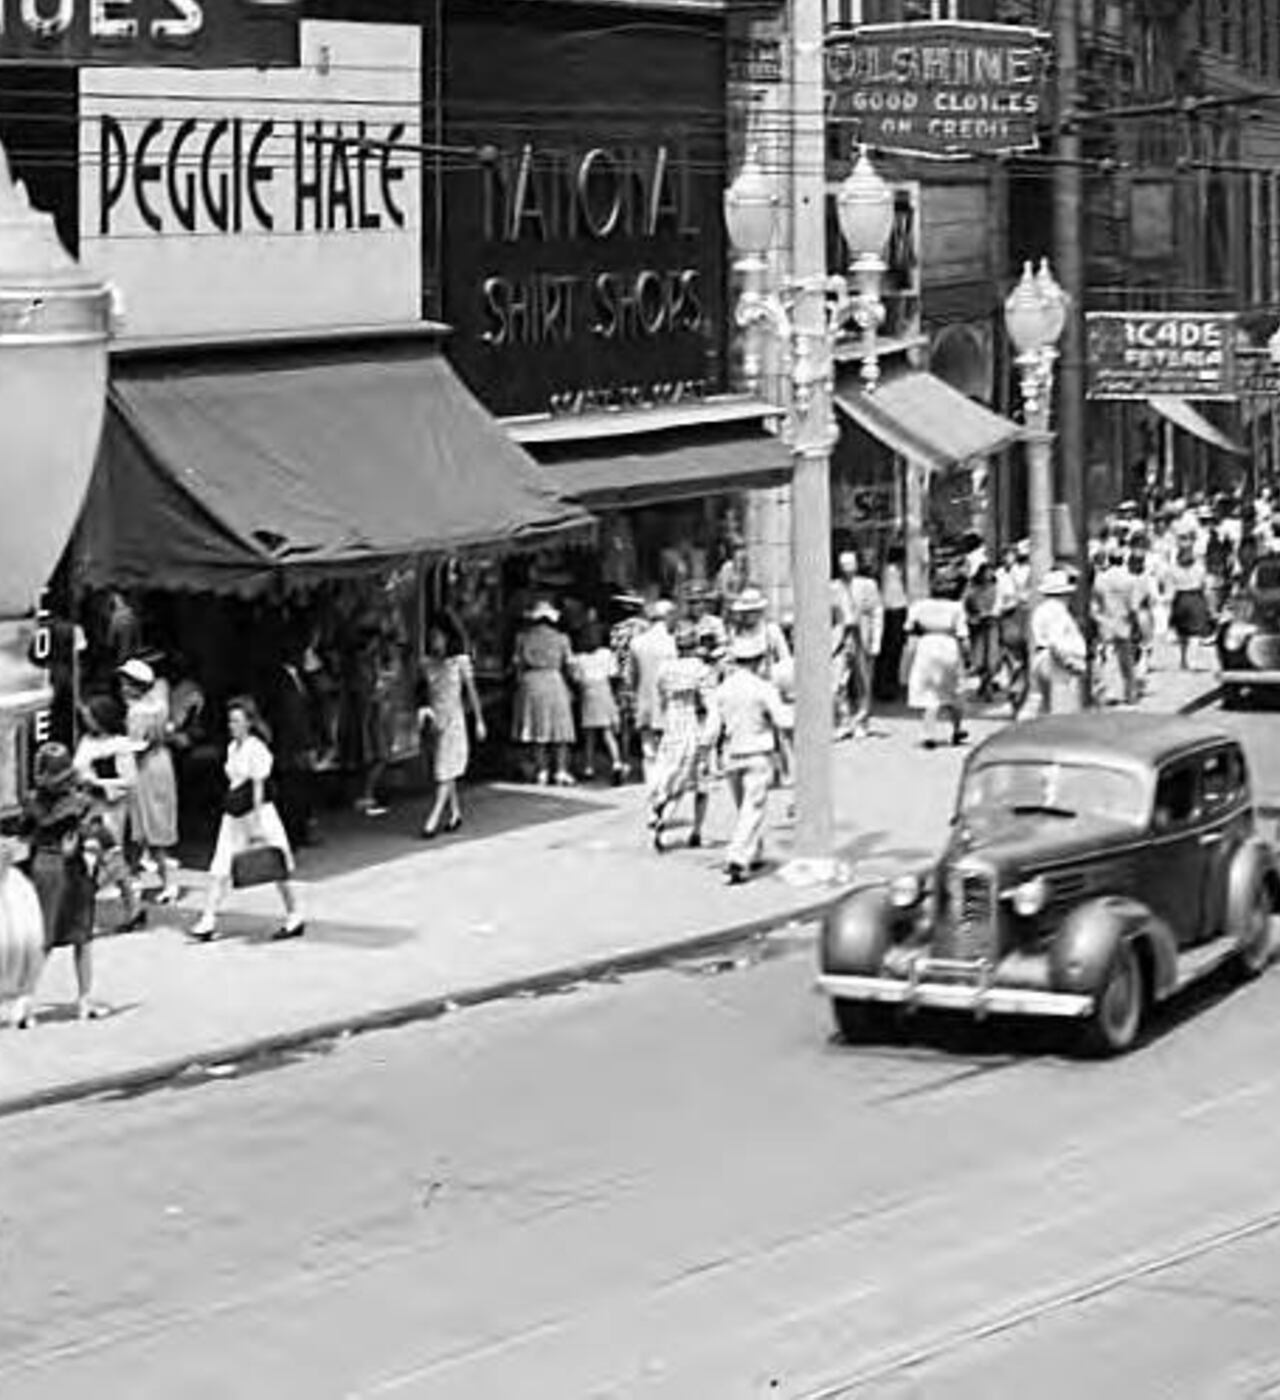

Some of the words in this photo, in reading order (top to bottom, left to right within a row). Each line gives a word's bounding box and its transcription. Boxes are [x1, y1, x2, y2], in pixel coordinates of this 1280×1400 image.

[852, 90, 919, 112] GOOD
[880, 117, 913, 135] ON
[927, 117, 1010, 139] CREDIT
[99, 114, 274, 234] PEGGIE
[294, 118, 408, 232] HALE
[482, 142, 702, 242] NATIONAL
[479, 275, 580, 345] SHIRT
[592, 269, 704, 338] SHOPS
